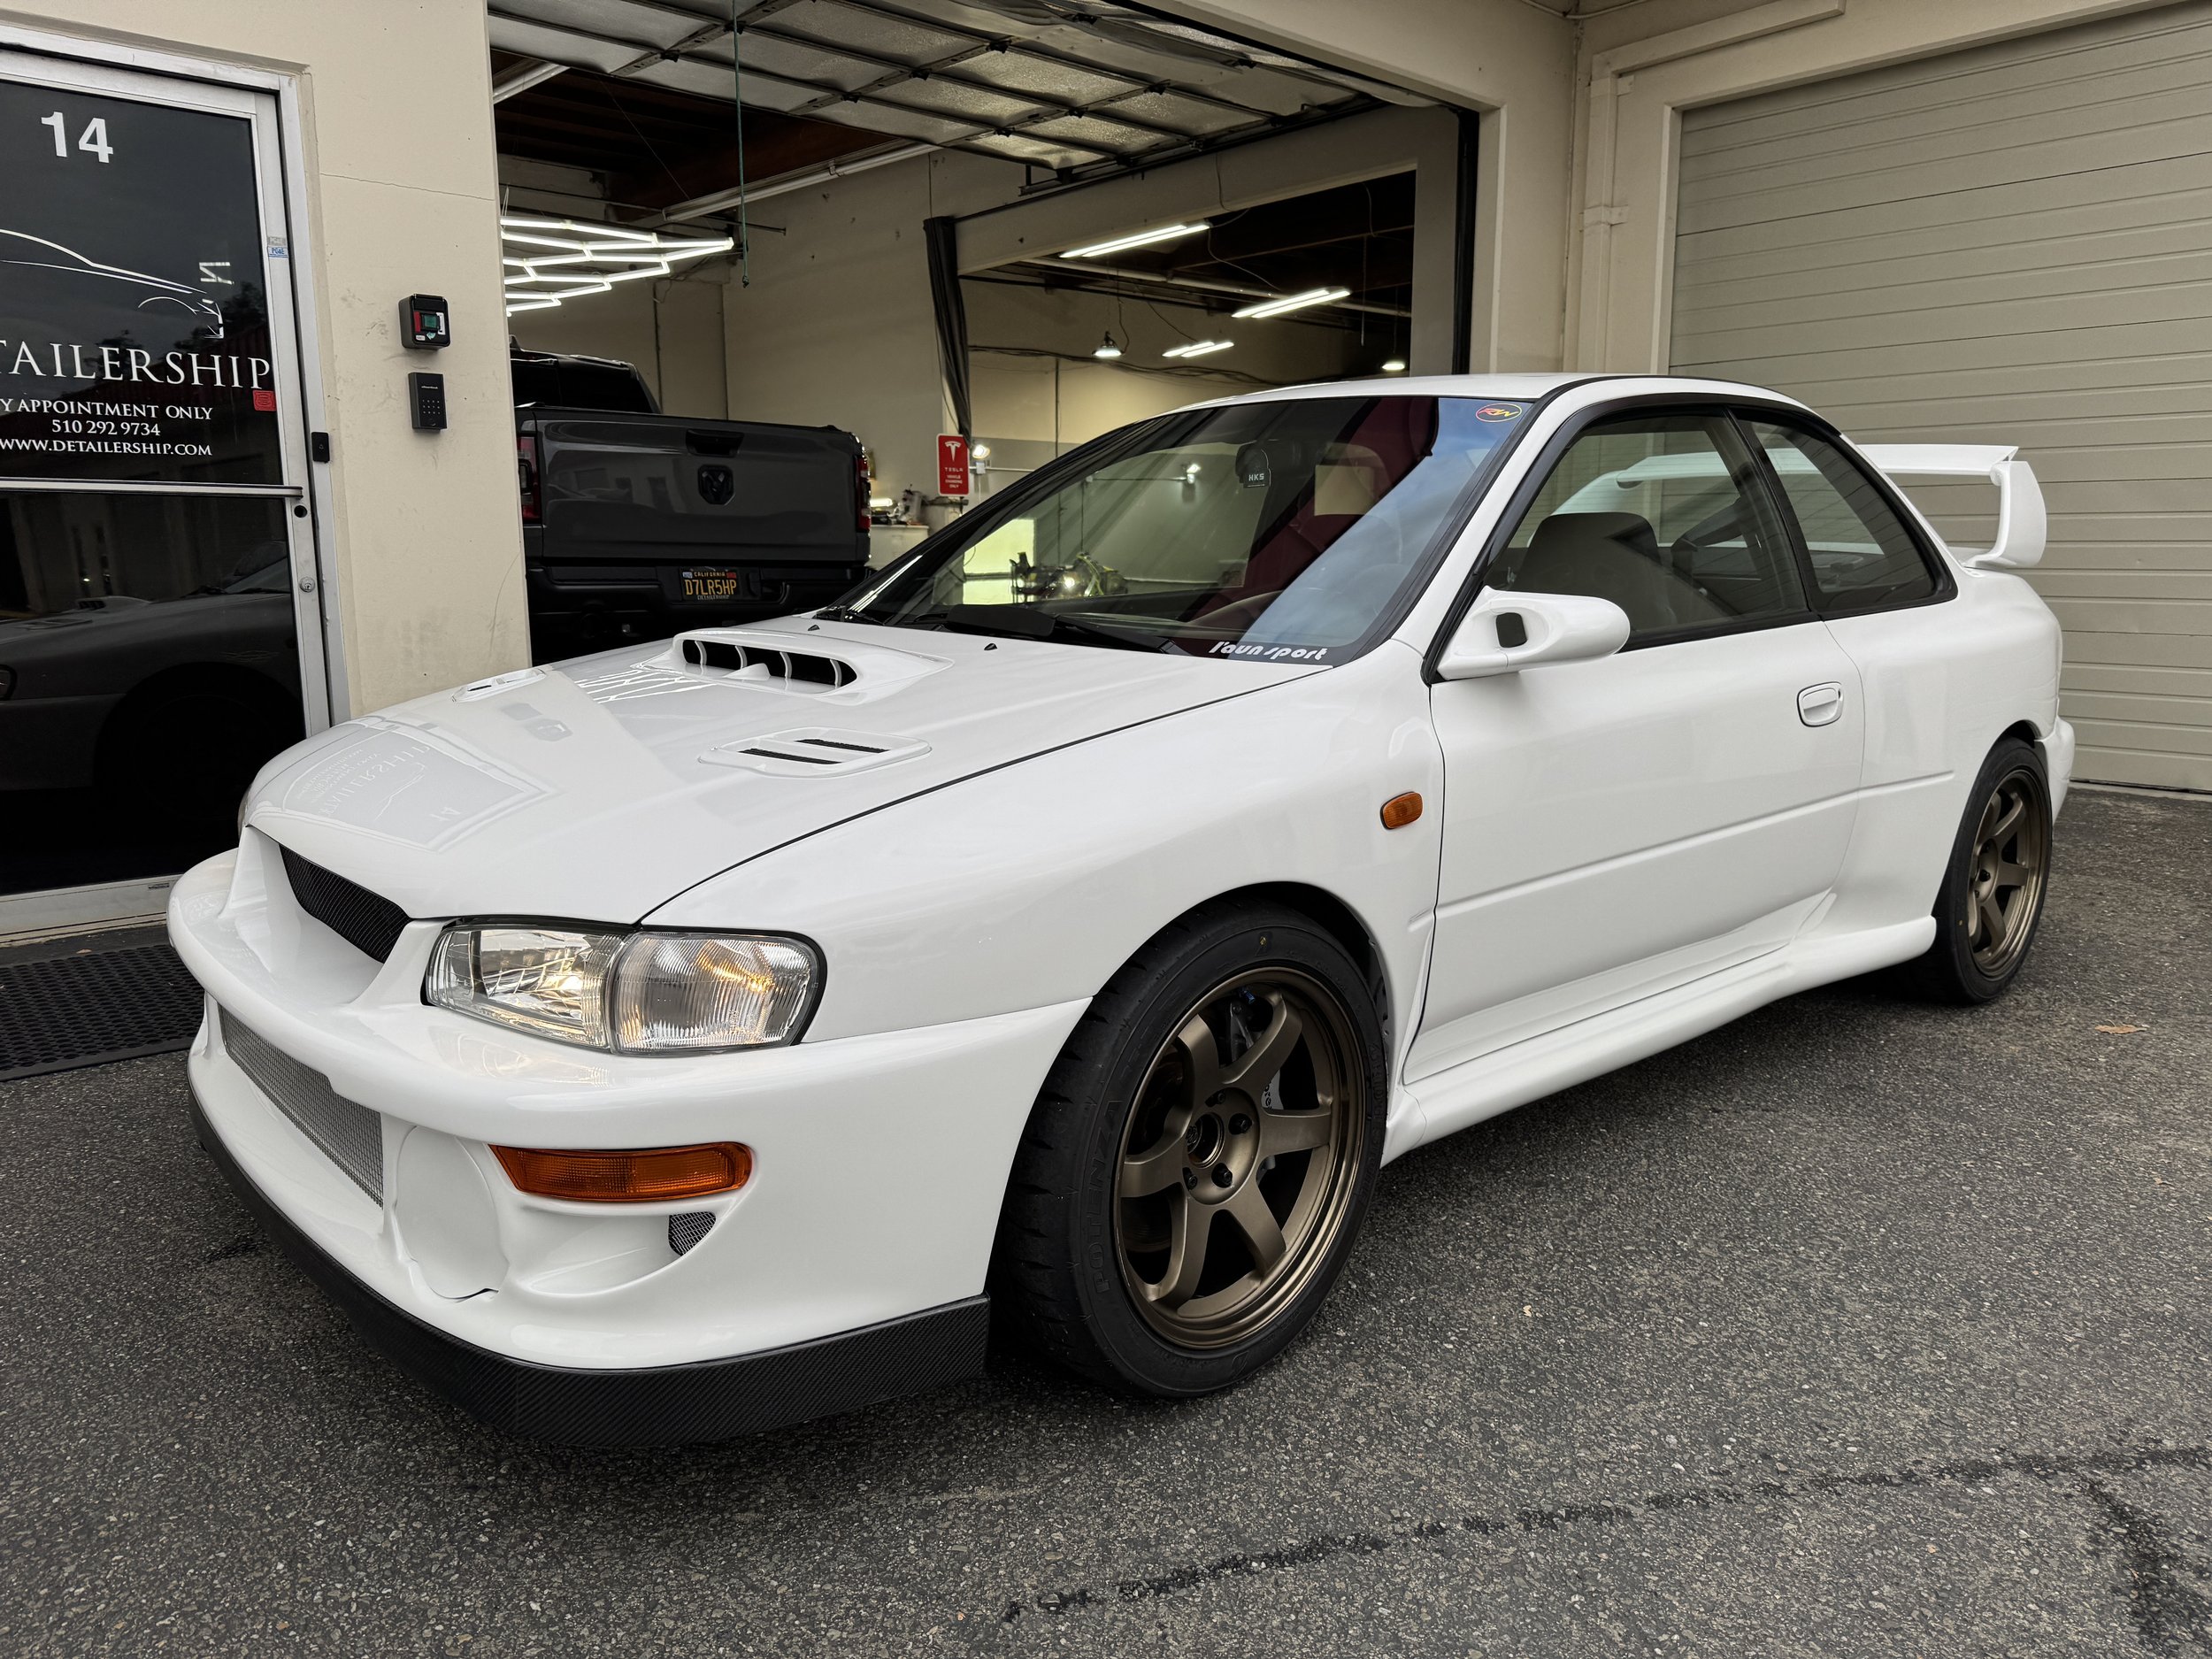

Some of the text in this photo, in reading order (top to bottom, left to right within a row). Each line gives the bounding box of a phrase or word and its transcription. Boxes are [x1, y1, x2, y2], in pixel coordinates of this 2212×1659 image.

[41, 111, 113, 163] 14
[17, 399, 159, 419] APPOINTMENT
[165, 405, 213, 420] ONLY
[51, 419, 160, 436] 510 292 9734
[0, 438, 212, 456] WWW.DETAILERSHIP.COM
[685, 580, 737, 595] D7LR5HP
[1086, 1100, 1125, 1294] POTENZA
